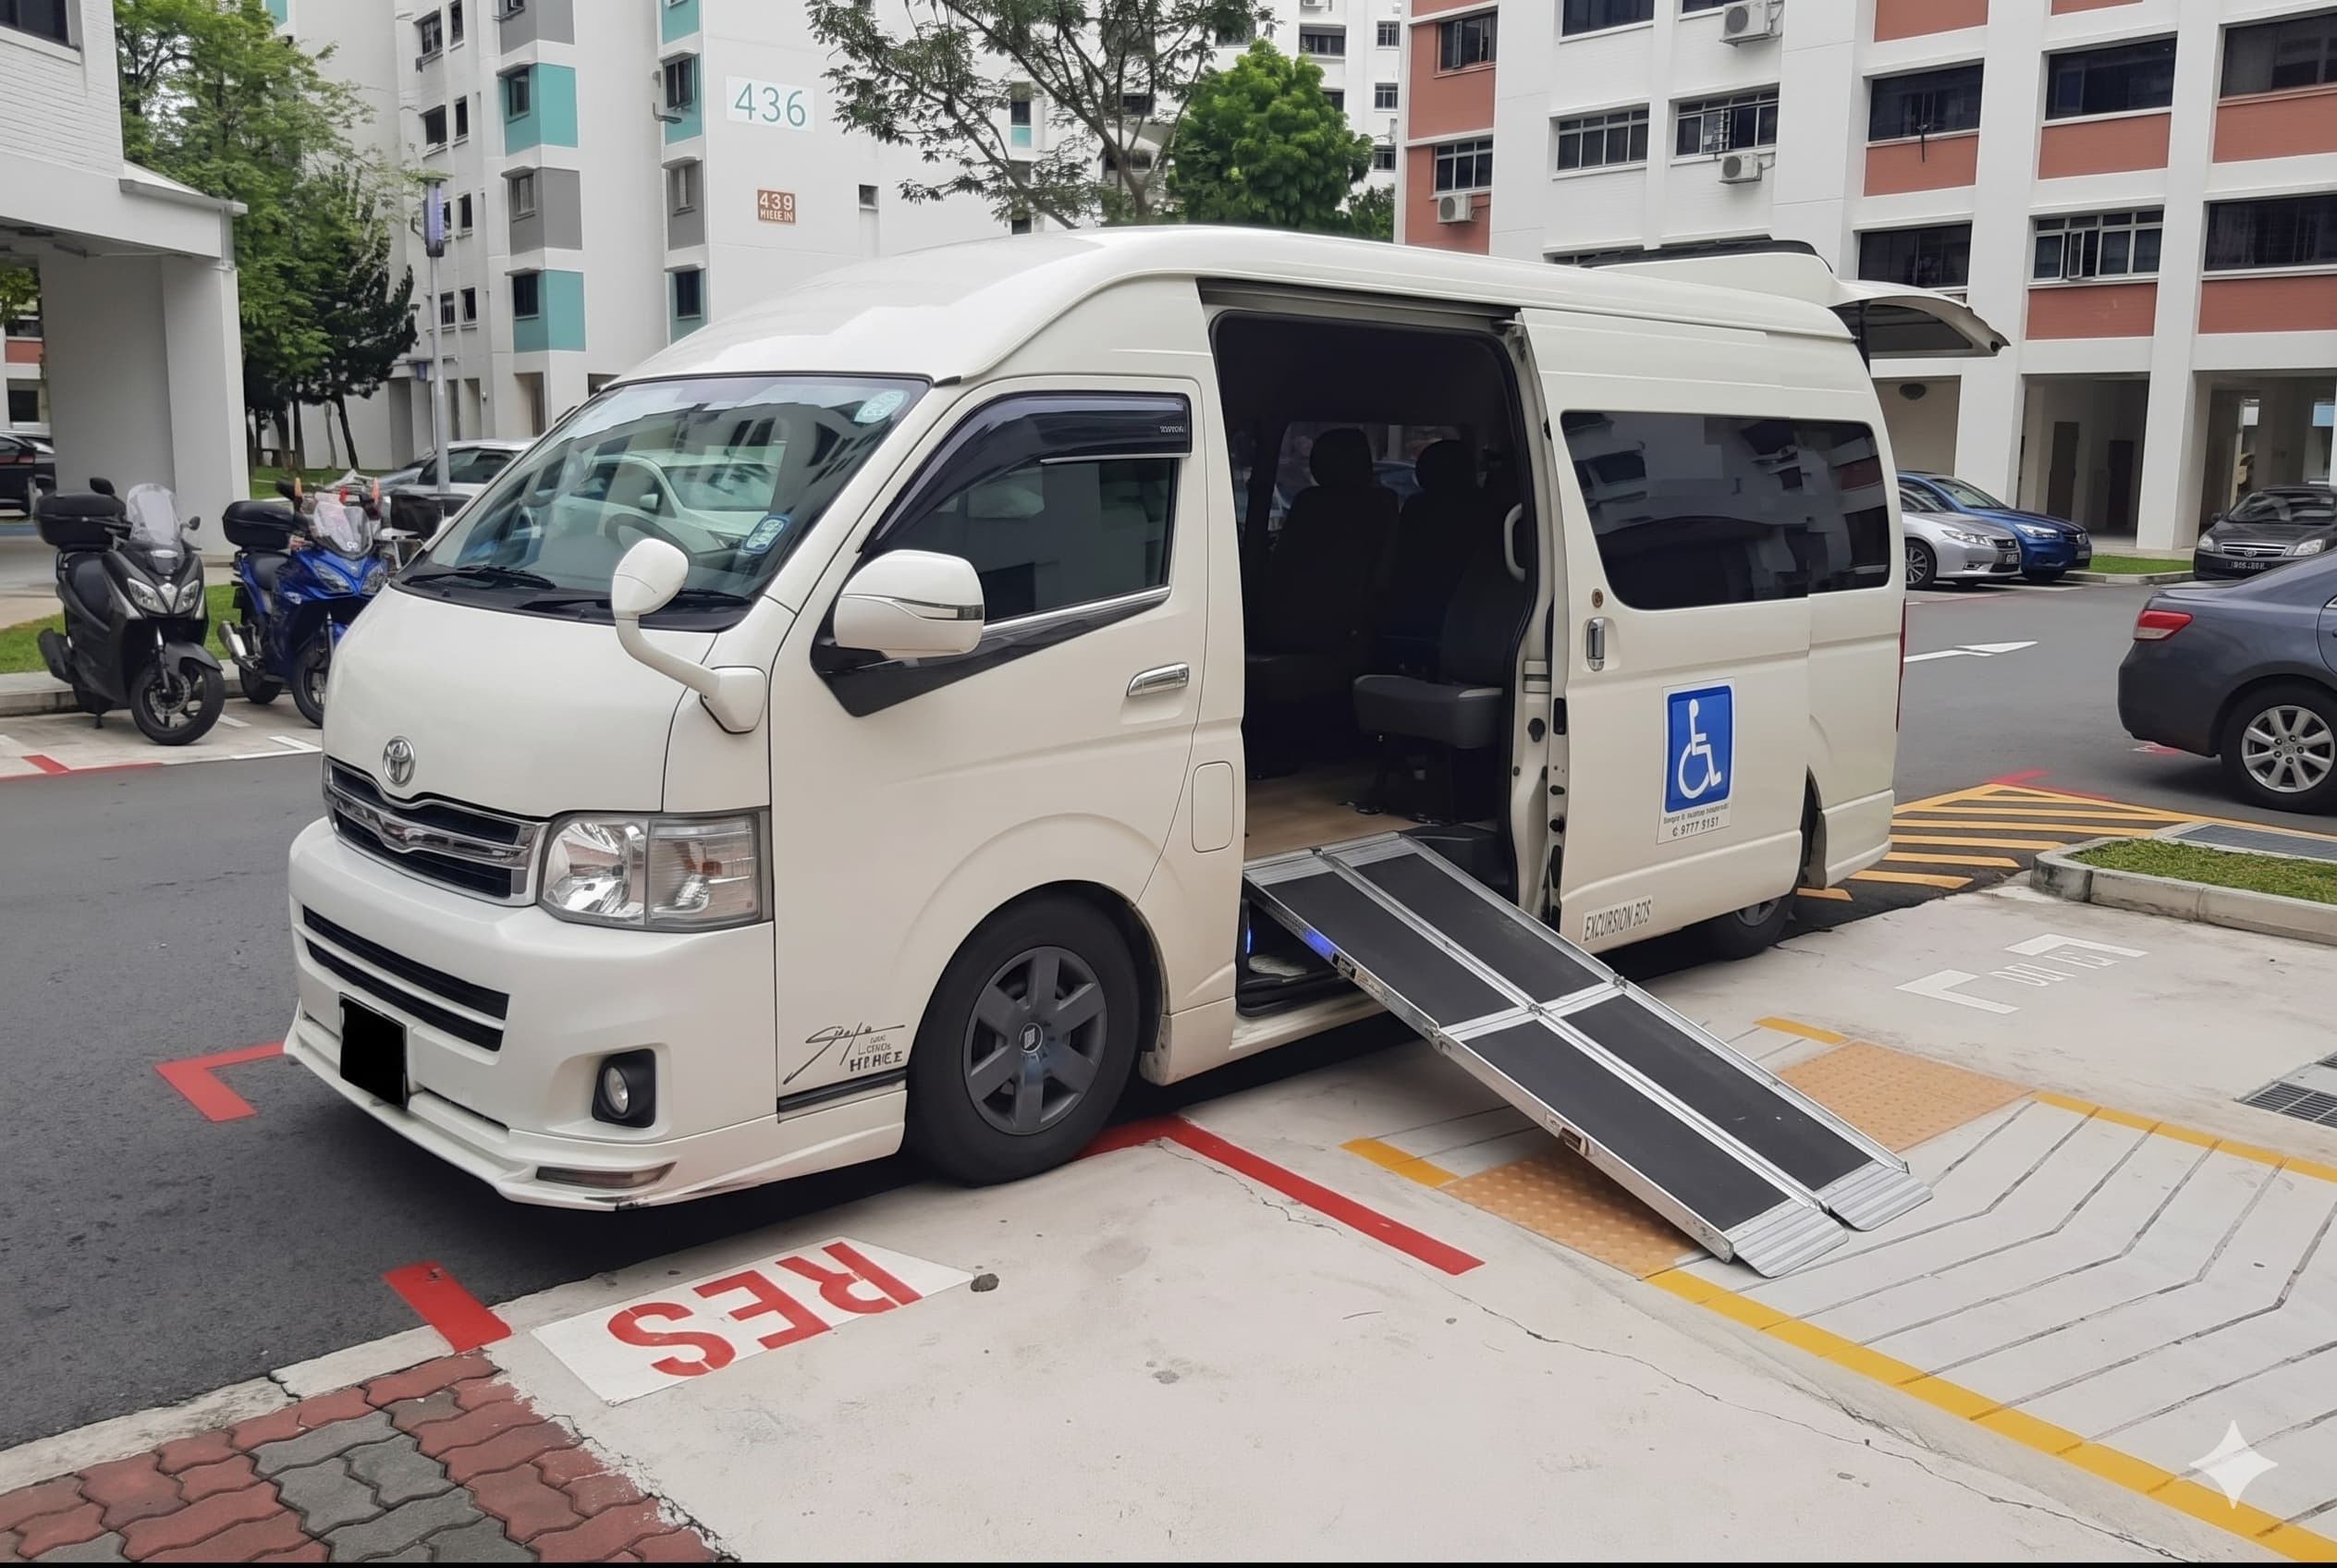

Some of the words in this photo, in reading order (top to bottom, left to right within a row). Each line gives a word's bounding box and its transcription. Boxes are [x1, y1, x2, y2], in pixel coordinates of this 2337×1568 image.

[734, 81, 806, 128] 436
[759, 191, 793, 211] 439
[1681, 821, 1699, 836] 9777
[1584, 903, 1634, 941] EXCURSION
[606, 1241, 924, 1377] RES
